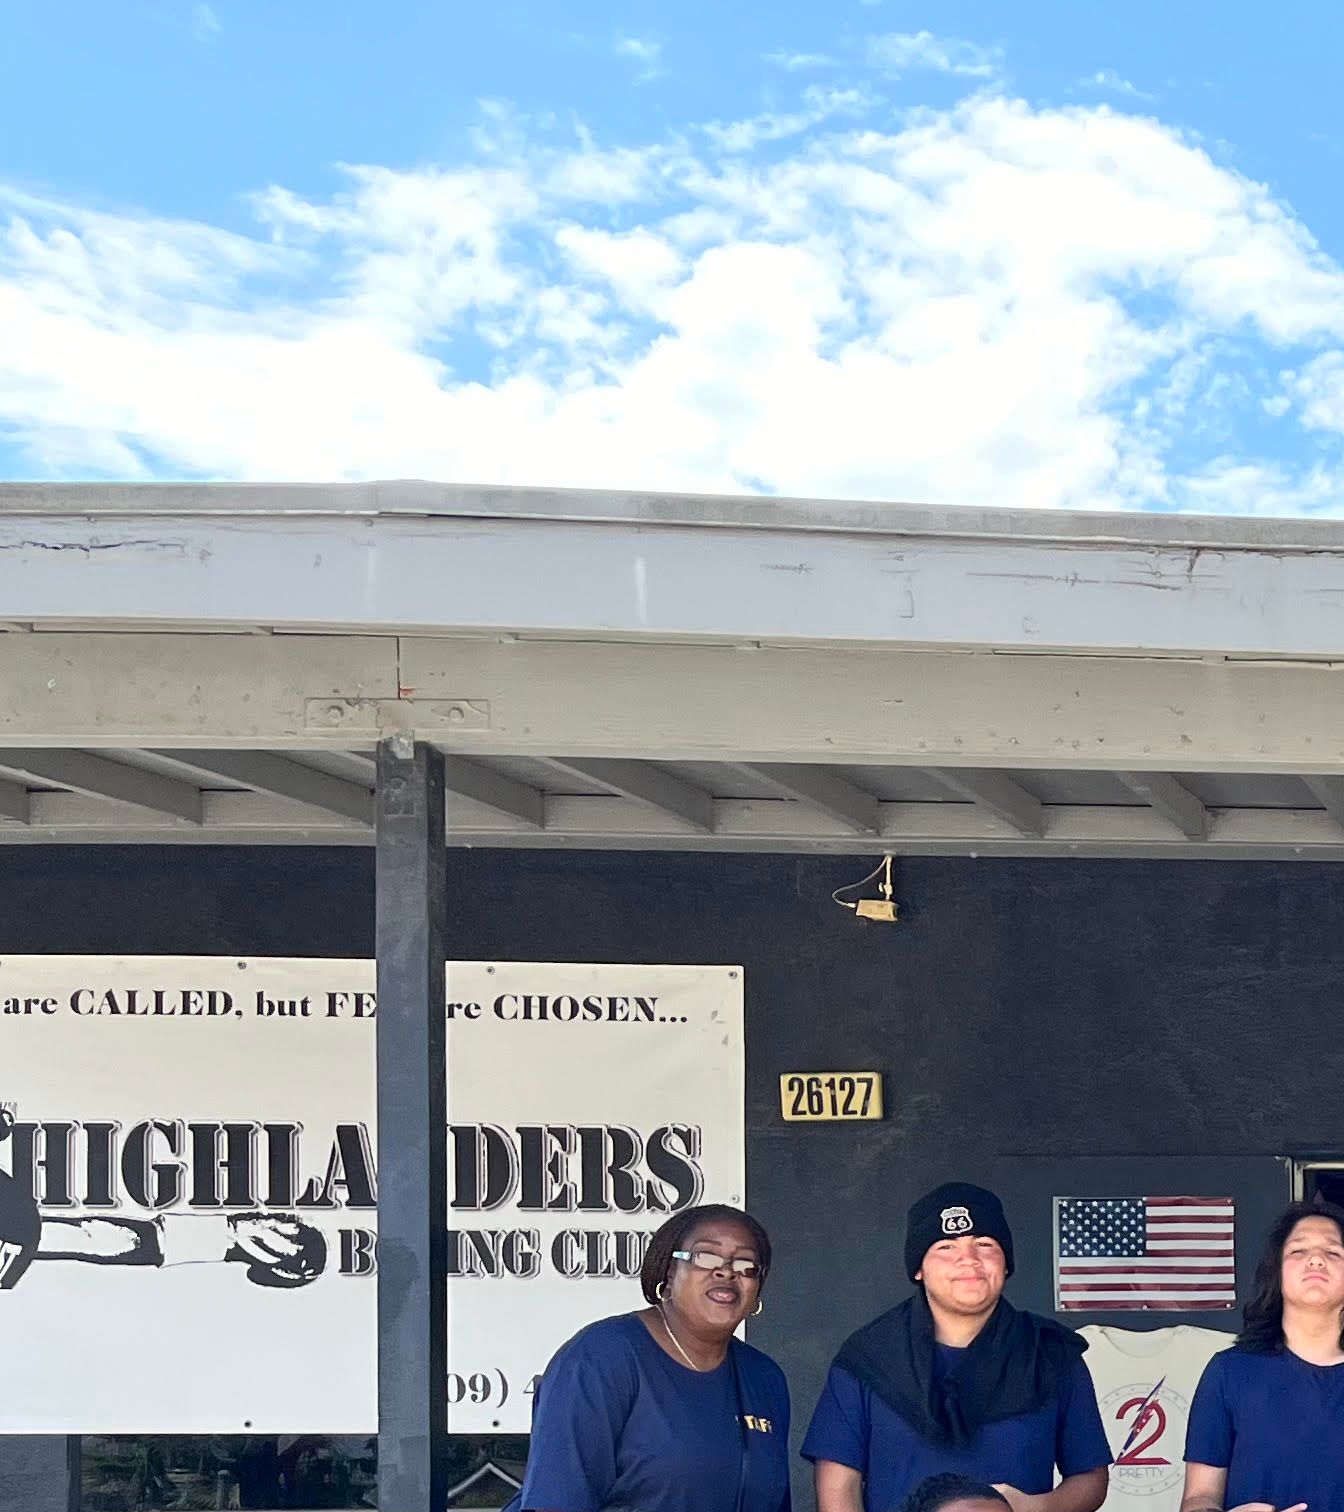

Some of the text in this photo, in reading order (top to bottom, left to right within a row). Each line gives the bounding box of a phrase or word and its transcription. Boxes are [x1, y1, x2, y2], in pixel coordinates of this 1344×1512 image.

[3, 987, 688, 1023] are CALLED, but FE re CHOSEN...
[788, 1076, 873, 1117] 26127
[14, 1118, 704, 1213] HIGHLADERS
[946, 1216, 968, 1230] 66
[338, 1228, 652, 1280] BING CLU
[1119, 1466, 1164, 1479] PRETTY
